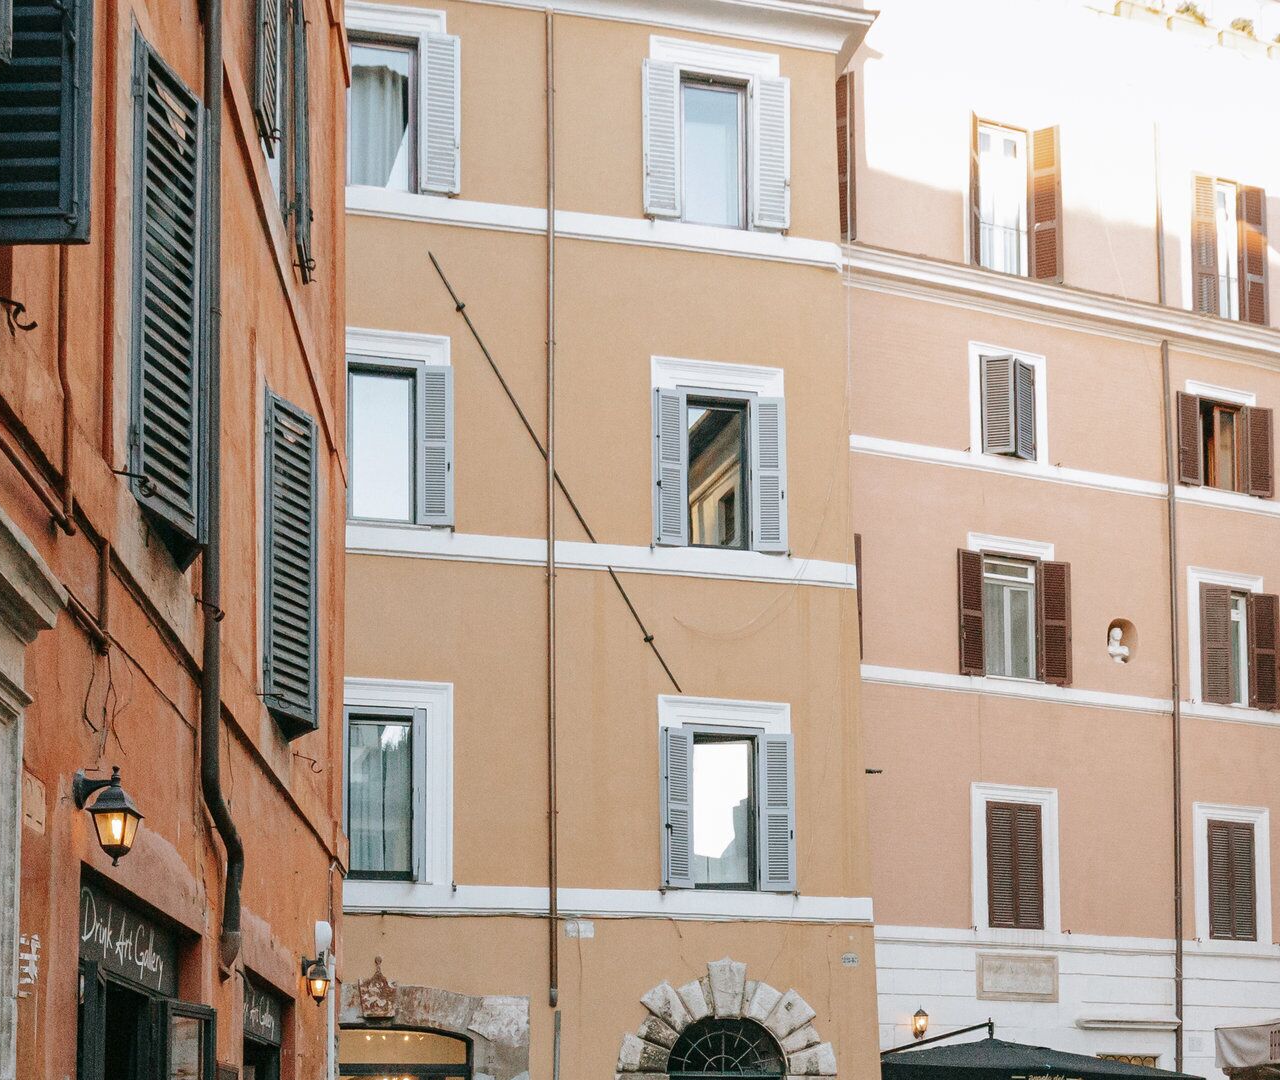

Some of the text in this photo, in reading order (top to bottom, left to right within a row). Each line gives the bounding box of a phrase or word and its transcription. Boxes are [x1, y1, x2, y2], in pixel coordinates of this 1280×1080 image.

[81, 886, 163, 991] Drink Art Gallery
[1270, 1030, 1280, 1060] BAR
